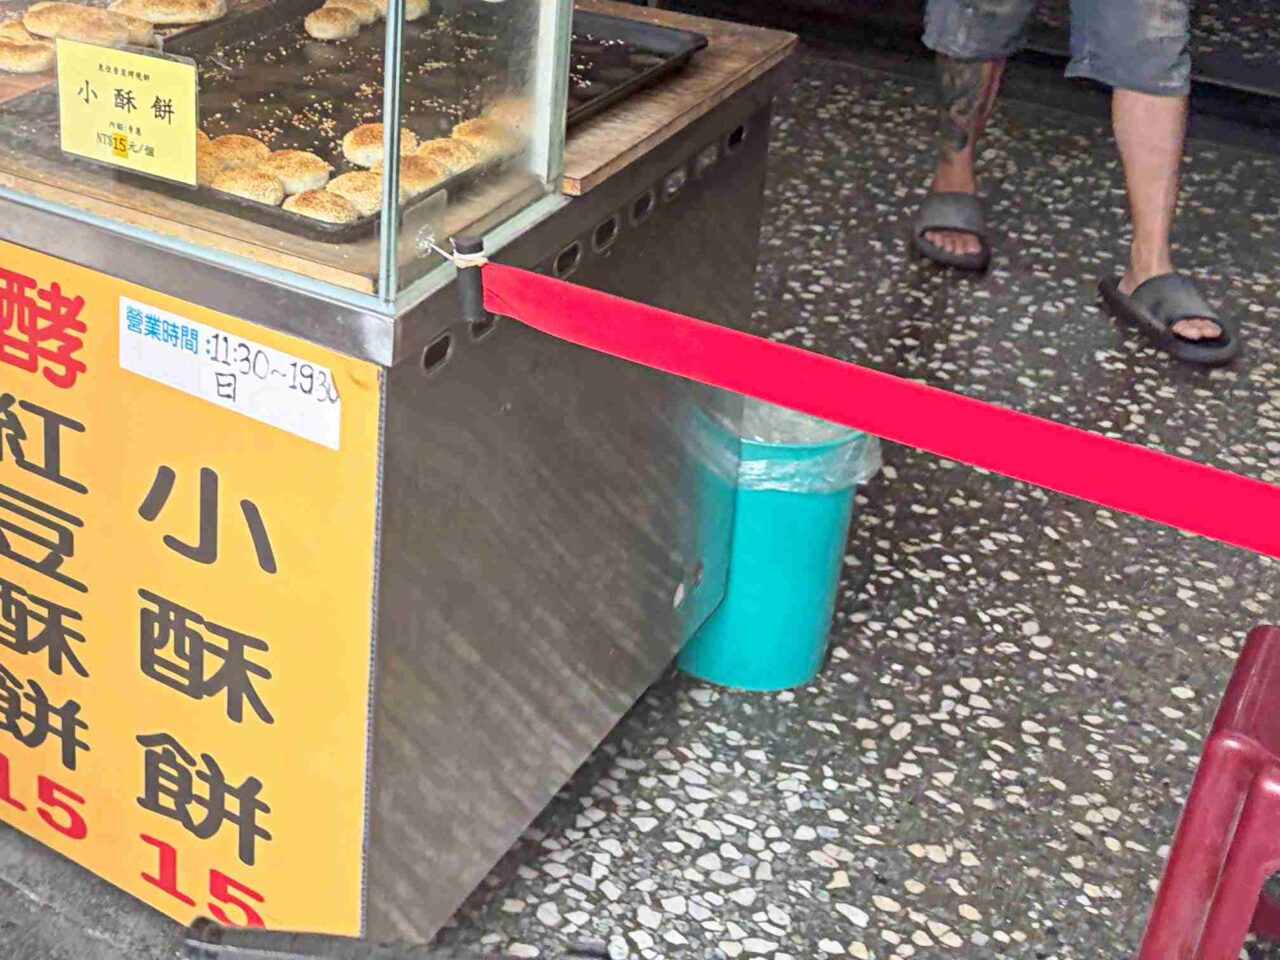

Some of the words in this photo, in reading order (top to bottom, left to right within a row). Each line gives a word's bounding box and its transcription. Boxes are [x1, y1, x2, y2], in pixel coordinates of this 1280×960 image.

[76, 79, 176, 126] 小酥餅
[214, 372, 237, 402] 日
[136, 465, 277, 866] 小酥餅
[139, 833, 266, 929] 15
